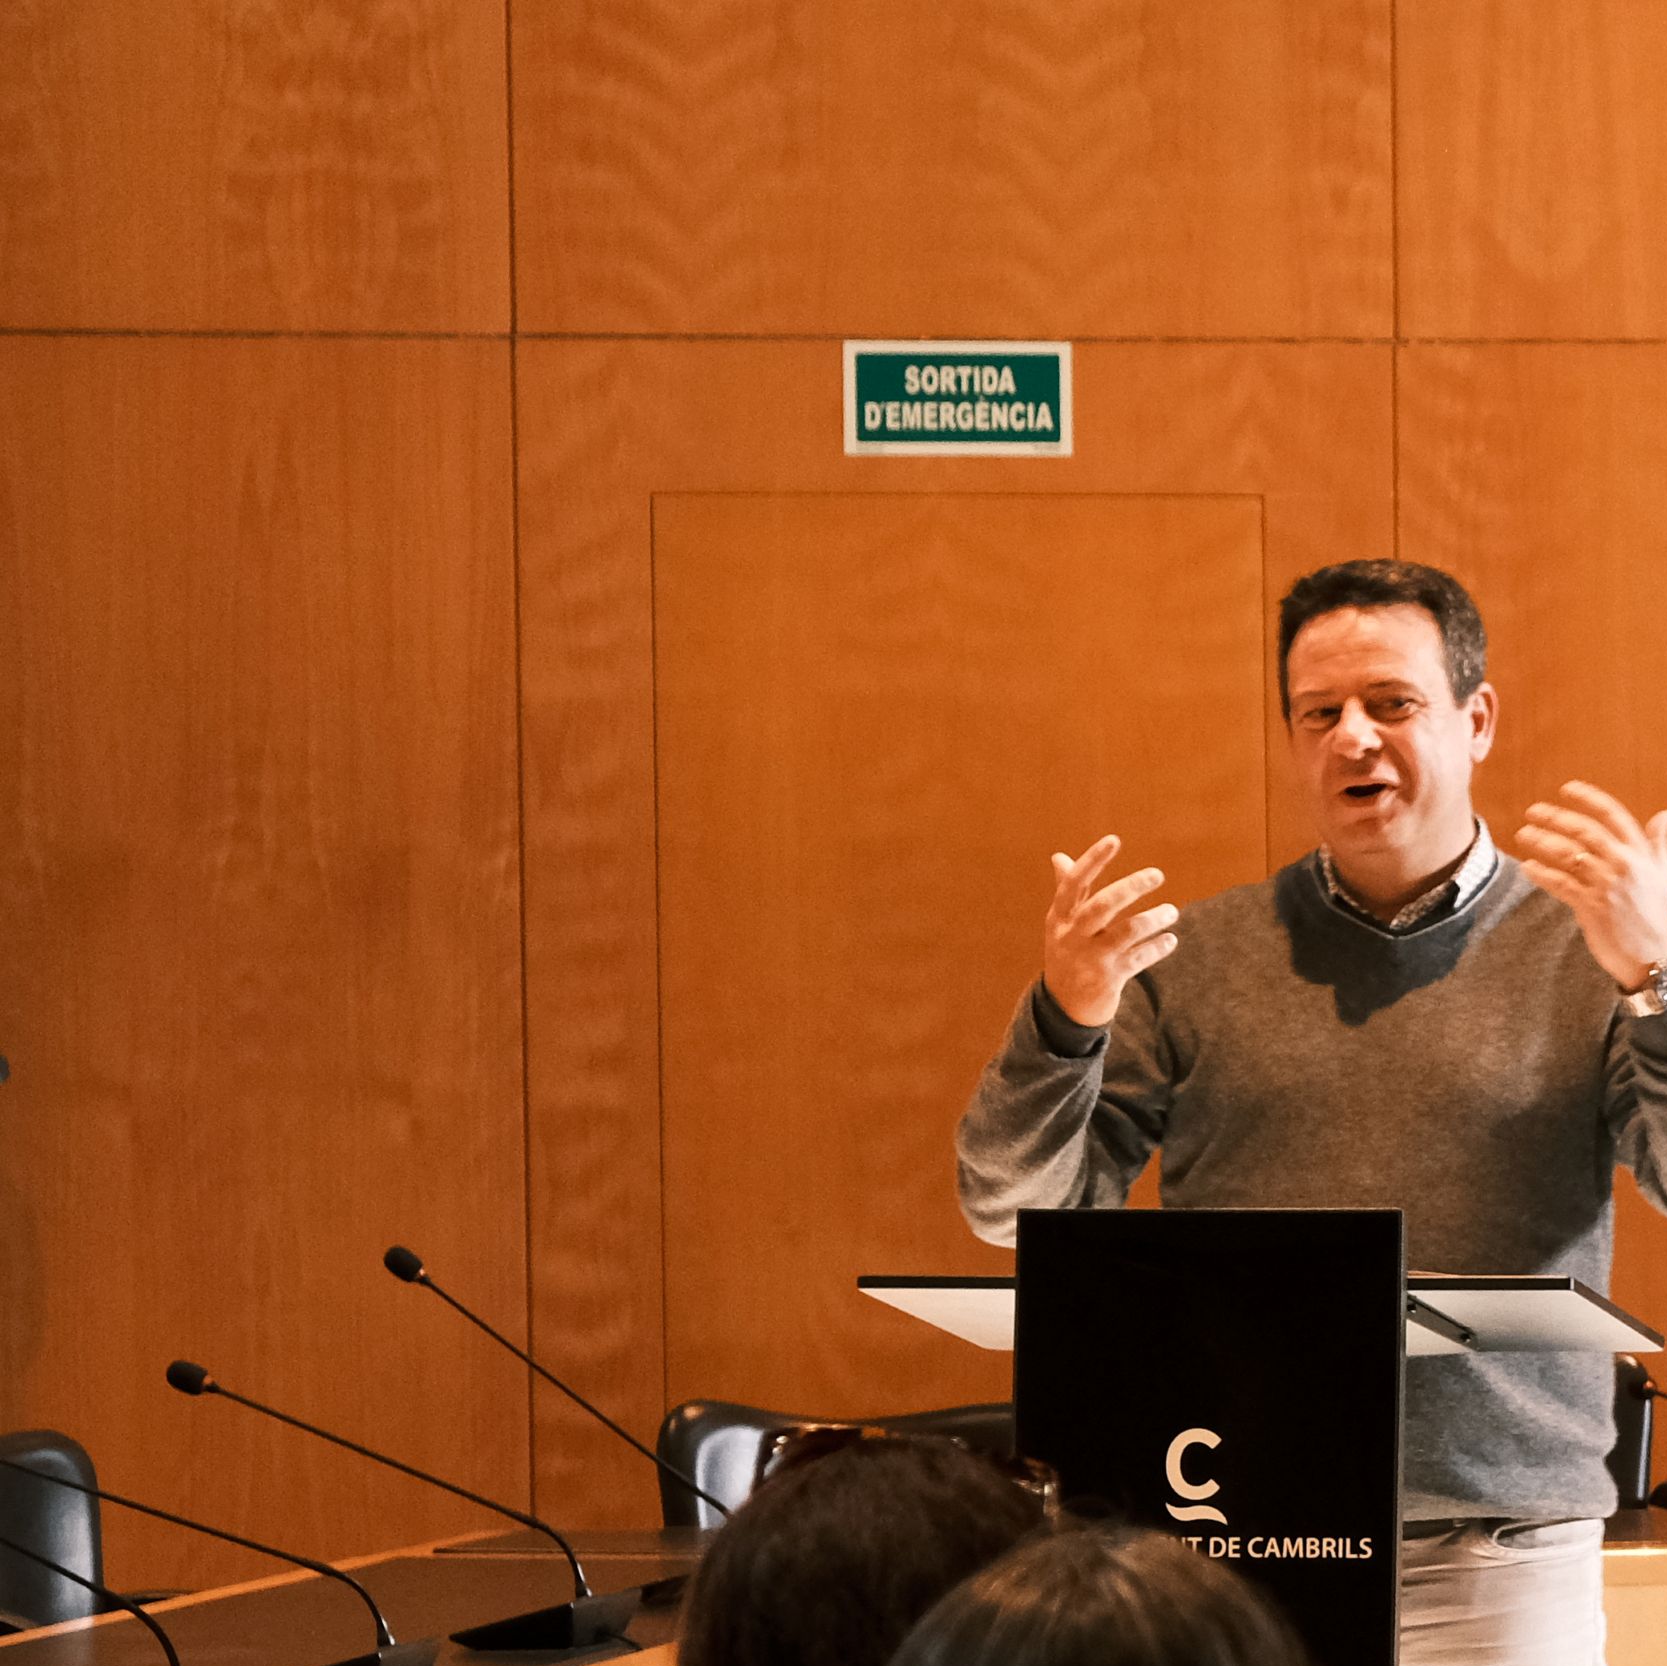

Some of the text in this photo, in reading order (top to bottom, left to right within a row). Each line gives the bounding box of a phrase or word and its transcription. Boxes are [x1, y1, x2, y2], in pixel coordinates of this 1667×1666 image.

[905, 365, 1015, 395] SORTIDA
[1165, 1427, 1222, 1500] C
[1208, 1536, 1241, 1559] DE
[1247, 1536, 1373, 1559] CAMBRILS
